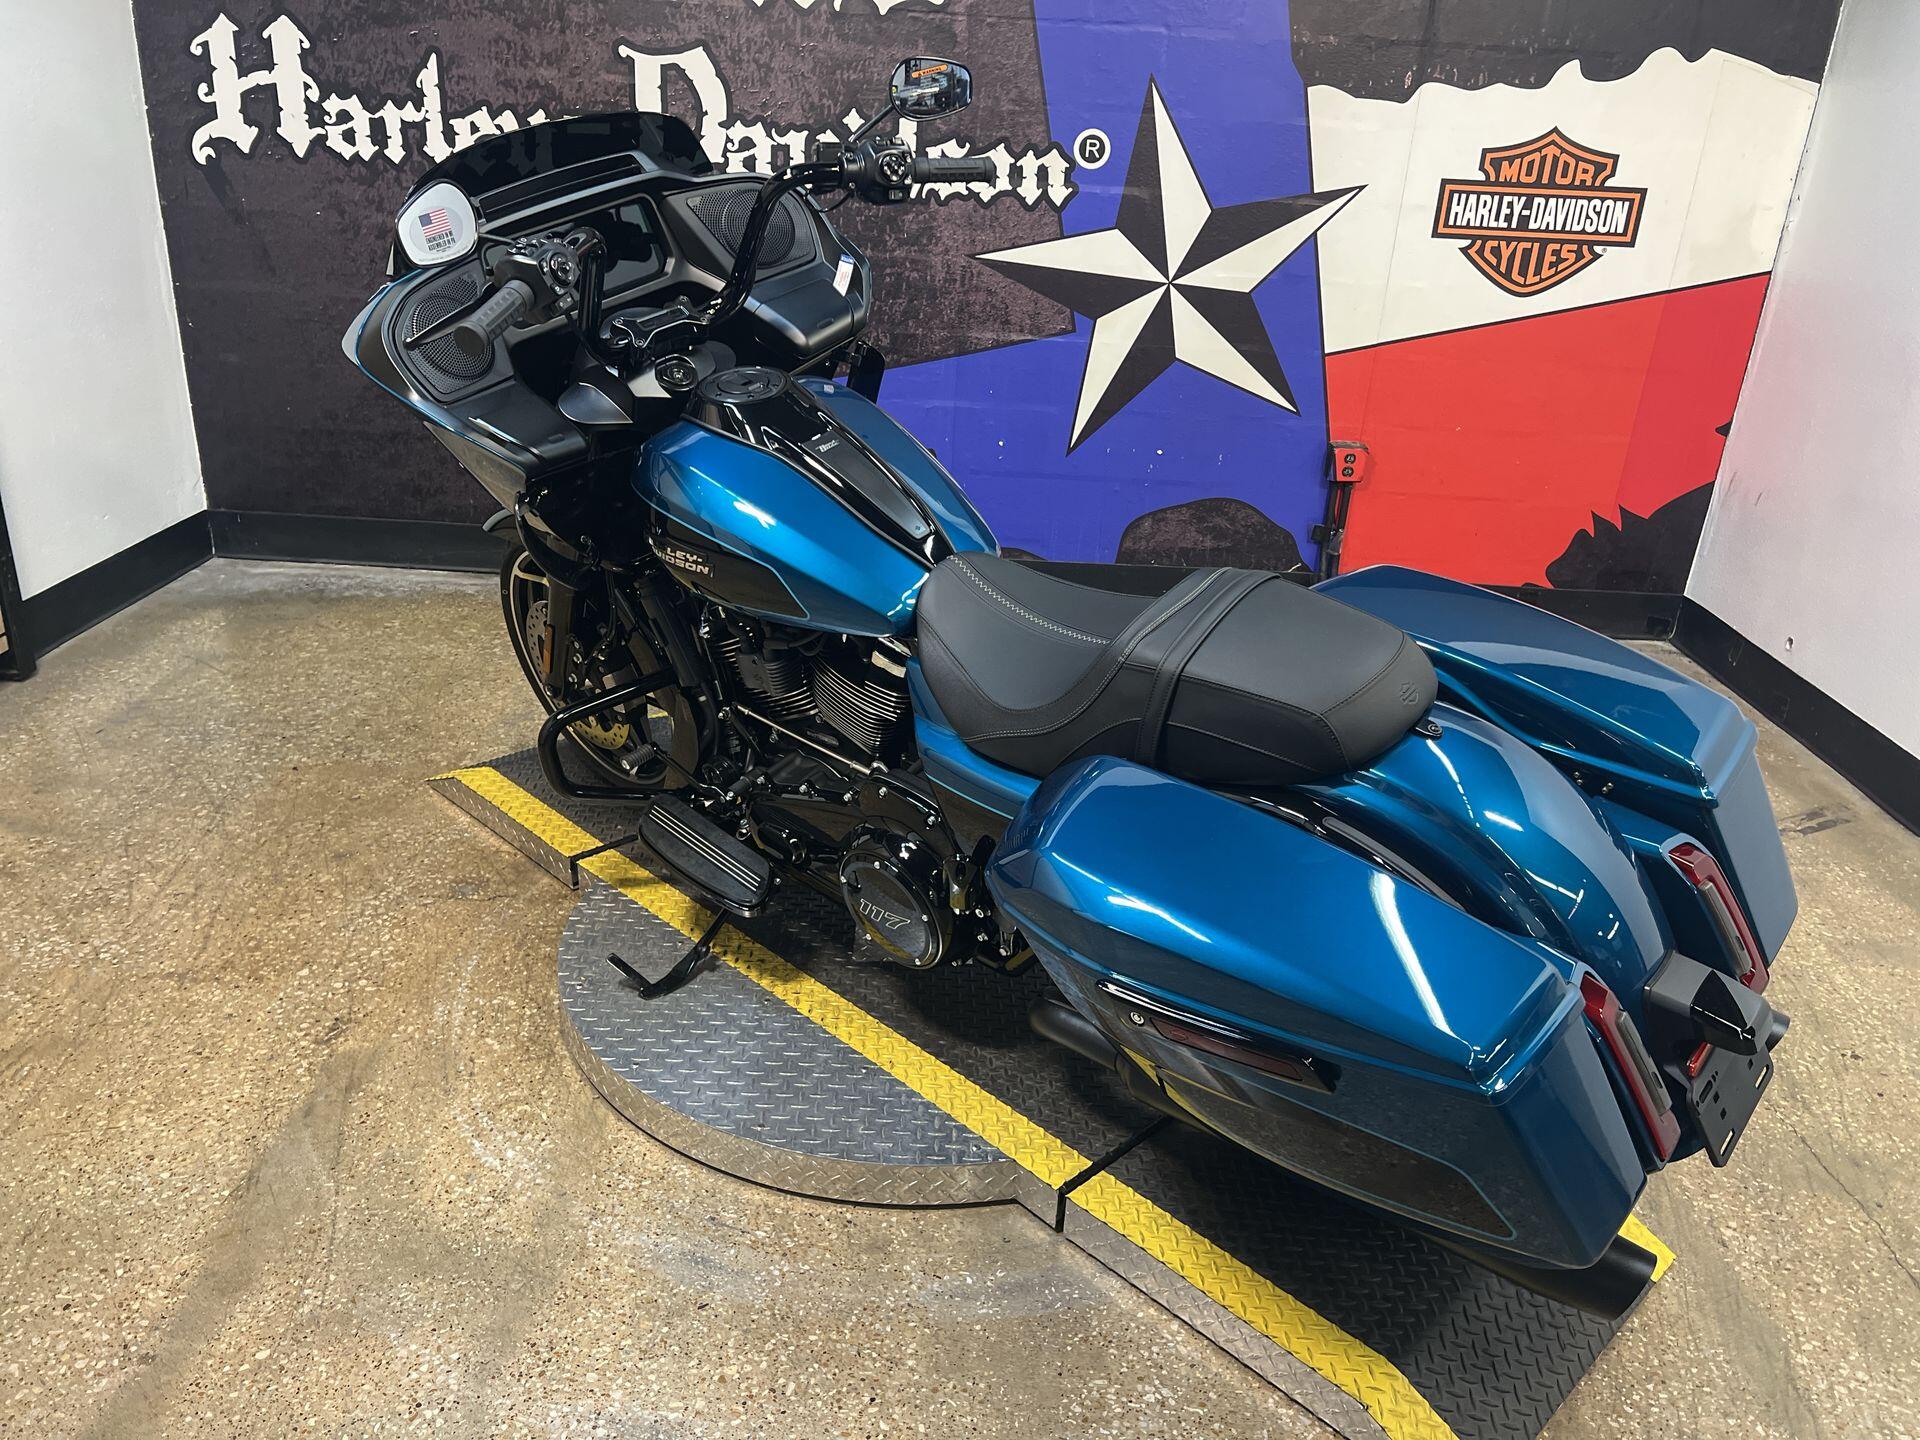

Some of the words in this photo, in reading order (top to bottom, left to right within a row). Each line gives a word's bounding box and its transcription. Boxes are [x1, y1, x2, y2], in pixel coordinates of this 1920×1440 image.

[1499, 144, 1595, 186] MOTOR
[1448, 193, 1630, 234] HARLEY-DAVIDSON
[1483, 240, 1578, 285] CYCLES
[859, 898, 911, 929] 117
